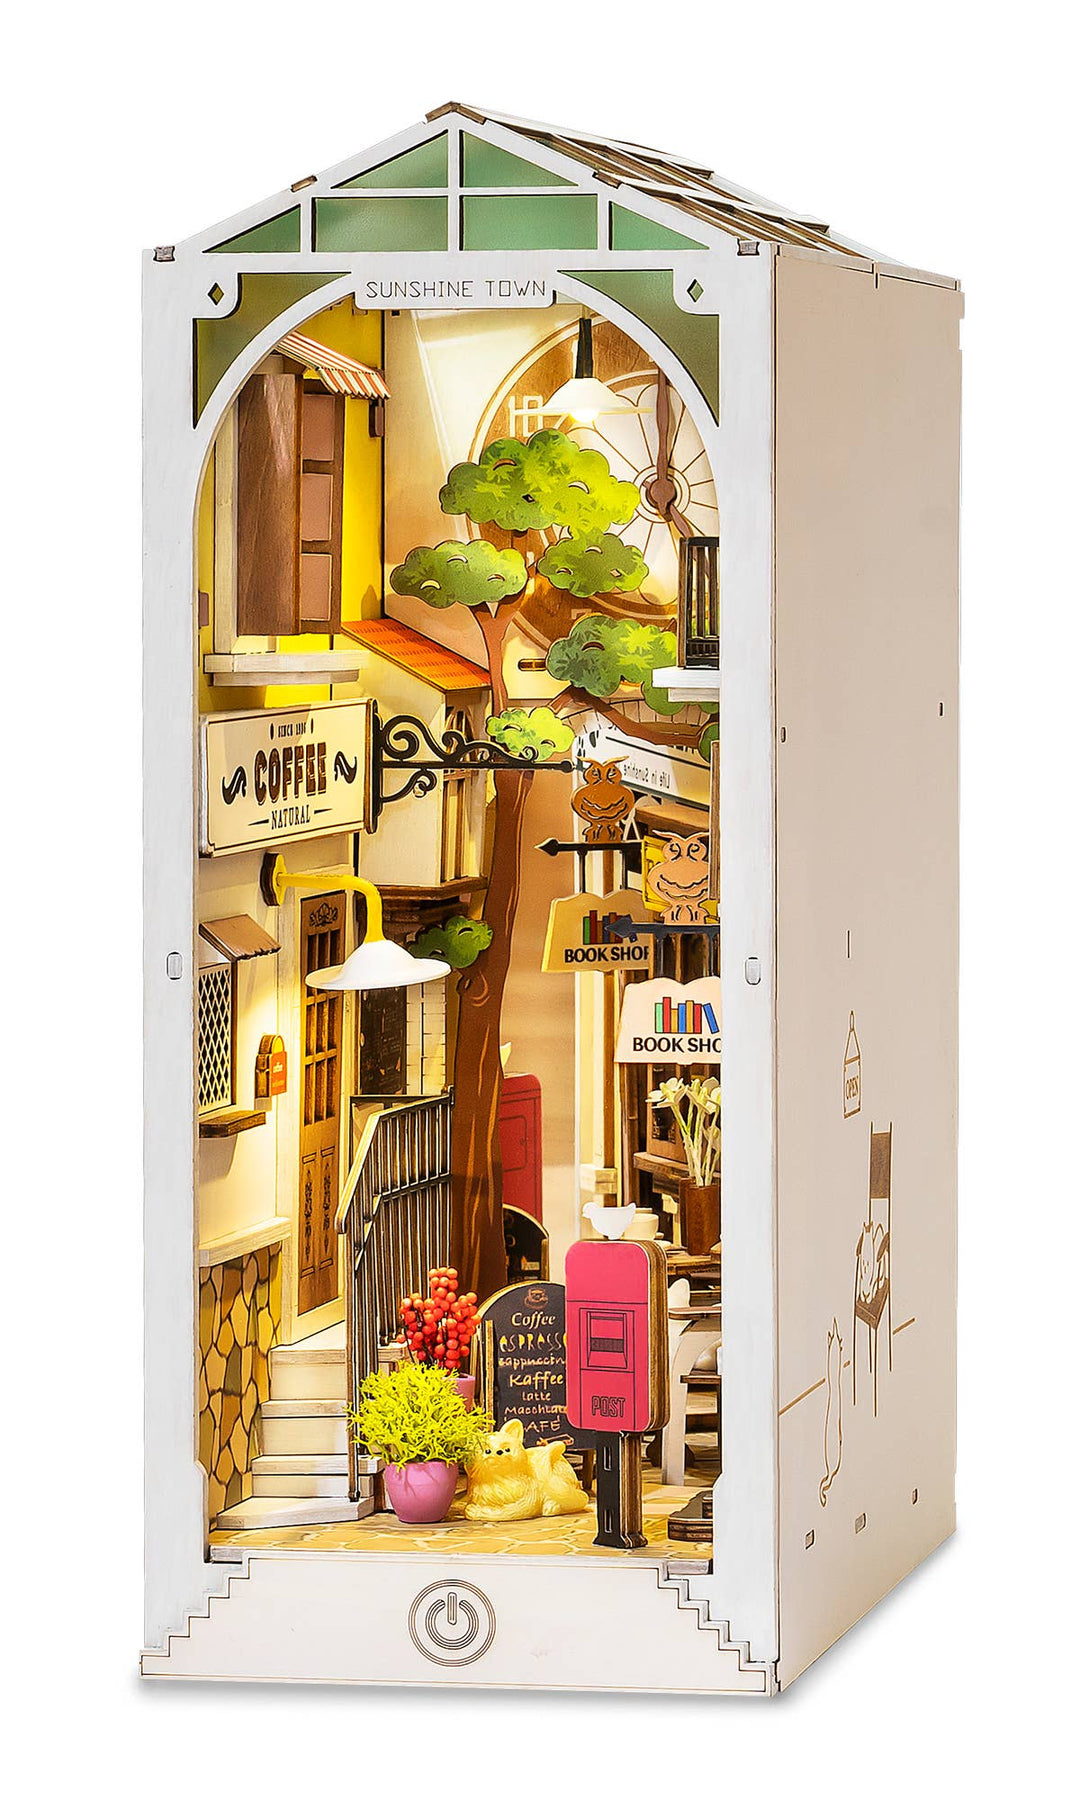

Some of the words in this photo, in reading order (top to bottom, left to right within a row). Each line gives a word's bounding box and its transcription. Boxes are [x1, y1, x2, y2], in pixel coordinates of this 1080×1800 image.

[366, 281, 474, 298] SUNSHINE
[485, 280, 546, 297] TOWN
[254, 742, 327, 806] COFFEE
[271, 804, 311, 830] NATURAL
[564, 948, 609, 963] BOOK
[633, 1037, 684, 1053] BOOK
[845, 1075, 859, 1100] OPEN
[511, 1311, 557, 1330] Coffee
[591, 1395, 626, 1418] POST
